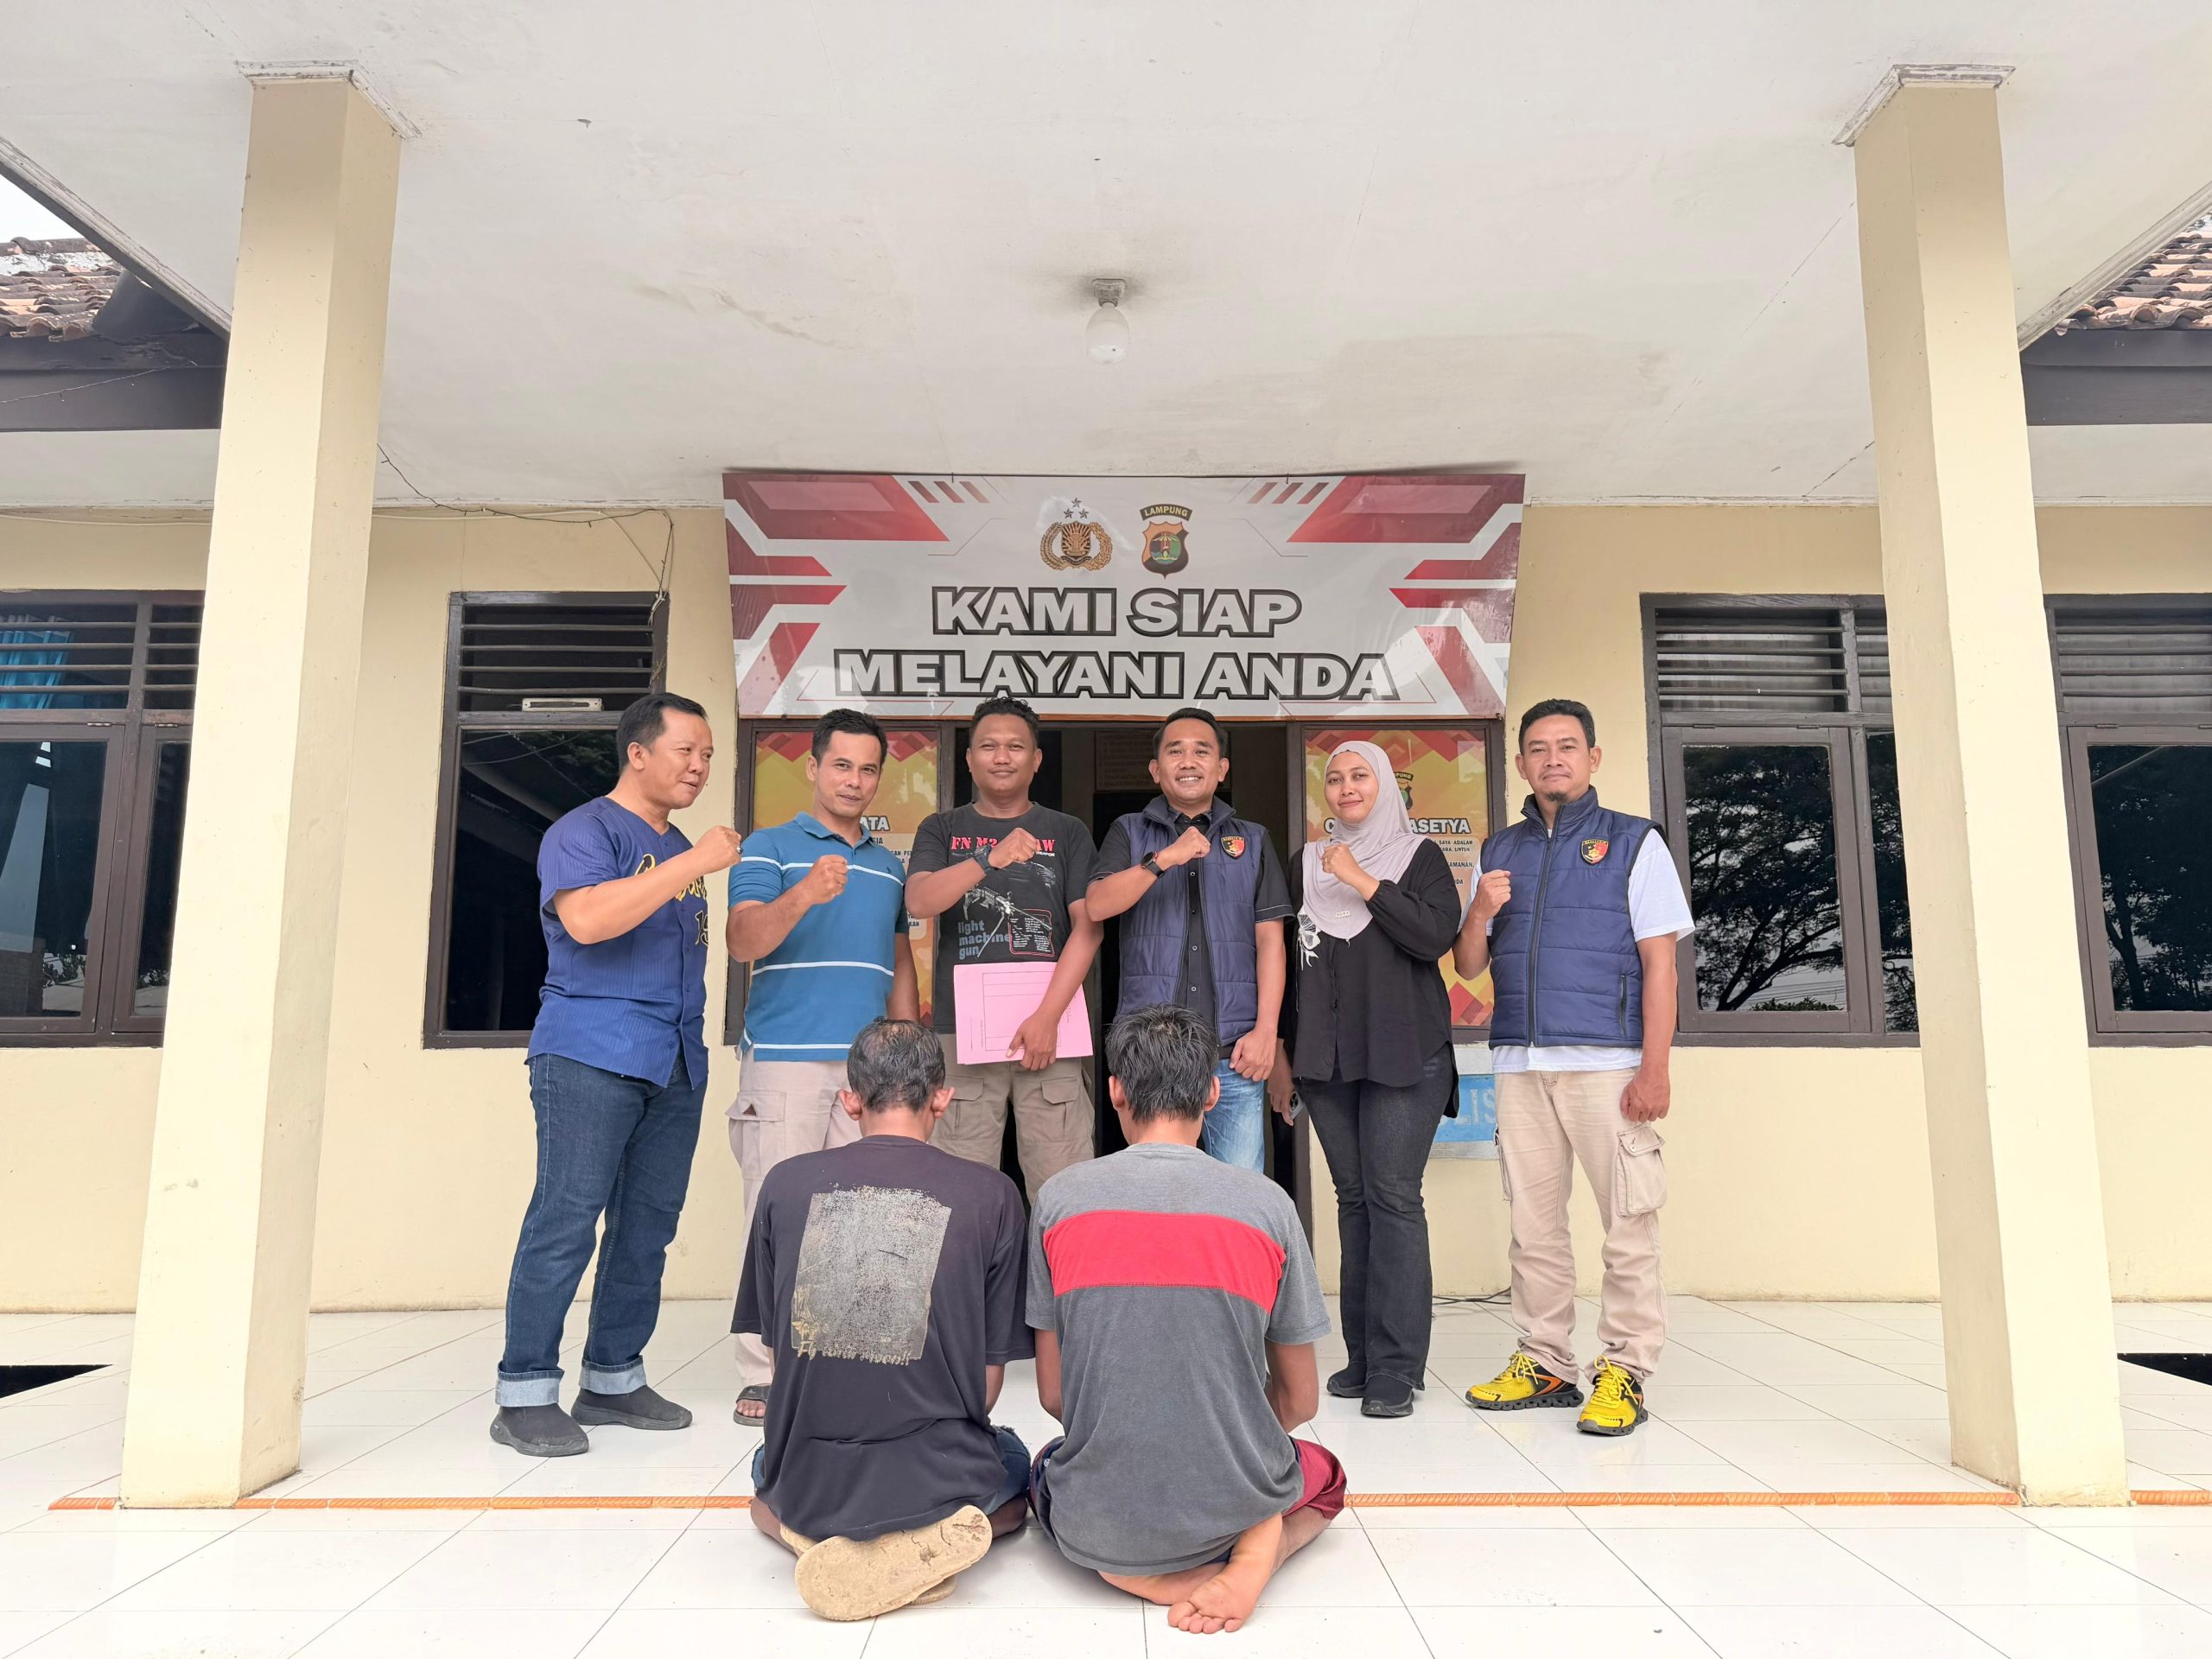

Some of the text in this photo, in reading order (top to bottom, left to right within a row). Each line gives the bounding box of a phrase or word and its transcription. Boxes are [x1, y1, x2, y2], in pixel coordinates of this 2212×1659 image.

[1144, 505, 1188, 518] LAMPUNG
[932, 586, 1303, 638] KAMI SIAP
[834, 649, 1401, 701] MELAYANI ANDA
[860, 816, 891, 831] ATA
[1408, 818, 1471, 834] ASETYA
[950, 836, 1055, 852] FN M2 AW
[958, 919, 985, 934] light
[959, 932, 1009, 946] machine
[959, 945, 980, 959] gun
